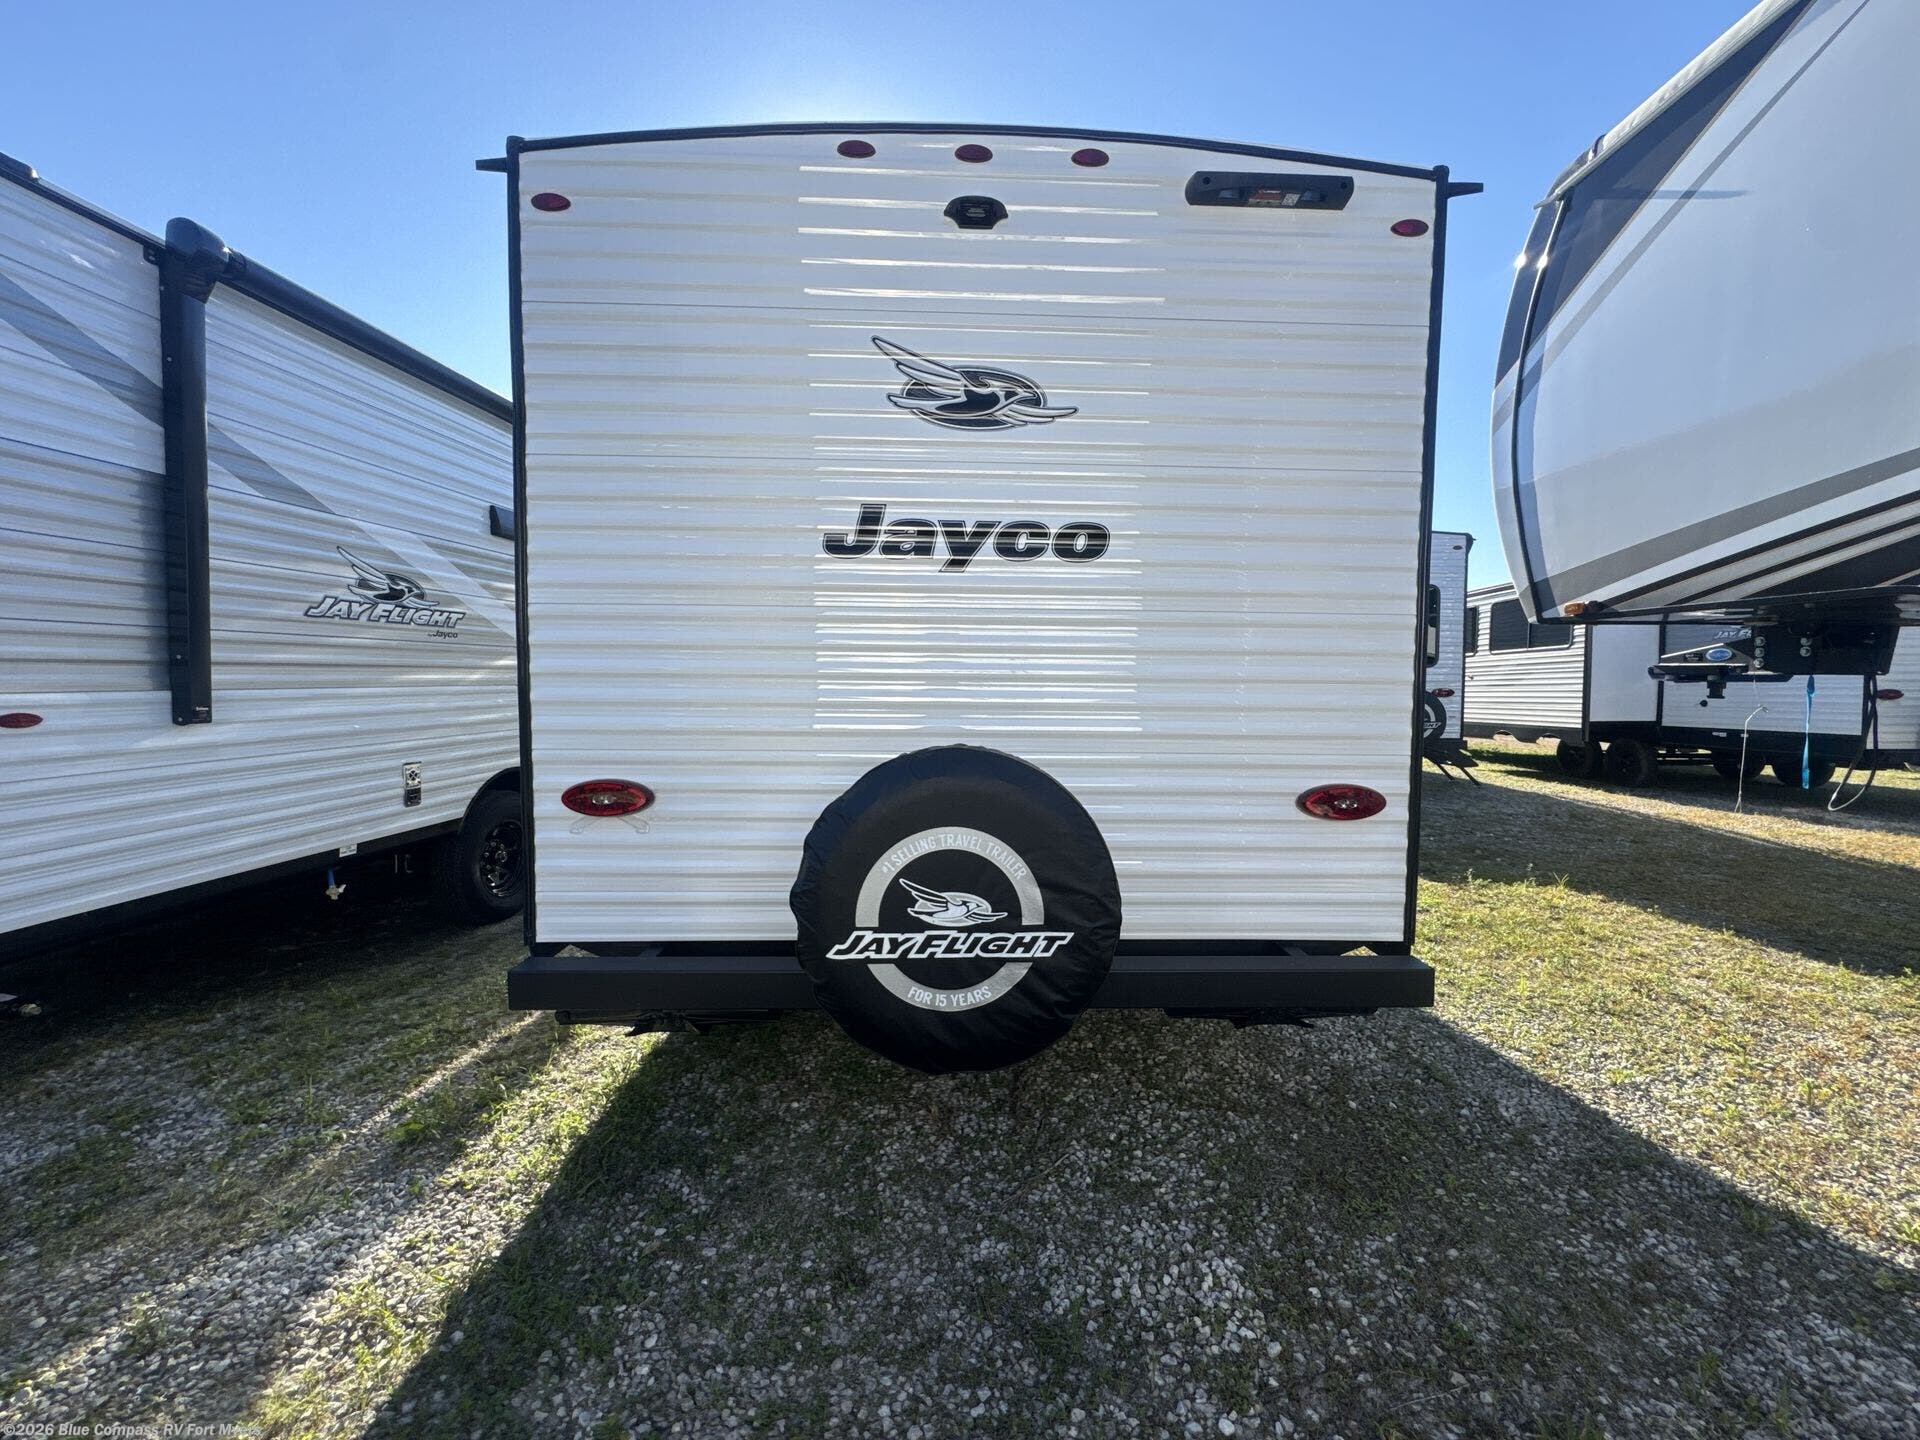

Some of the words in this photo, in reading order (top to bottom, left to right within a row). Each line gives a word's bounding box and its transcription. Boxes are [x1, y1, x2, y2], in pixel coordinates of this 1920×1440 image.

[822, 503, 1111, 573] Jayco
[432, 630, 458, 639] Jayco
[891, 836, 937, 866] SELLING
[938, 833, 982, 850] TRAVEL
[985, 841, 1027, 879] TRAILER
[907, 986, 933, 1005] FOR
[935, 993, 947, 1007] 15
[950, 985, 992, 1007] YEARS
